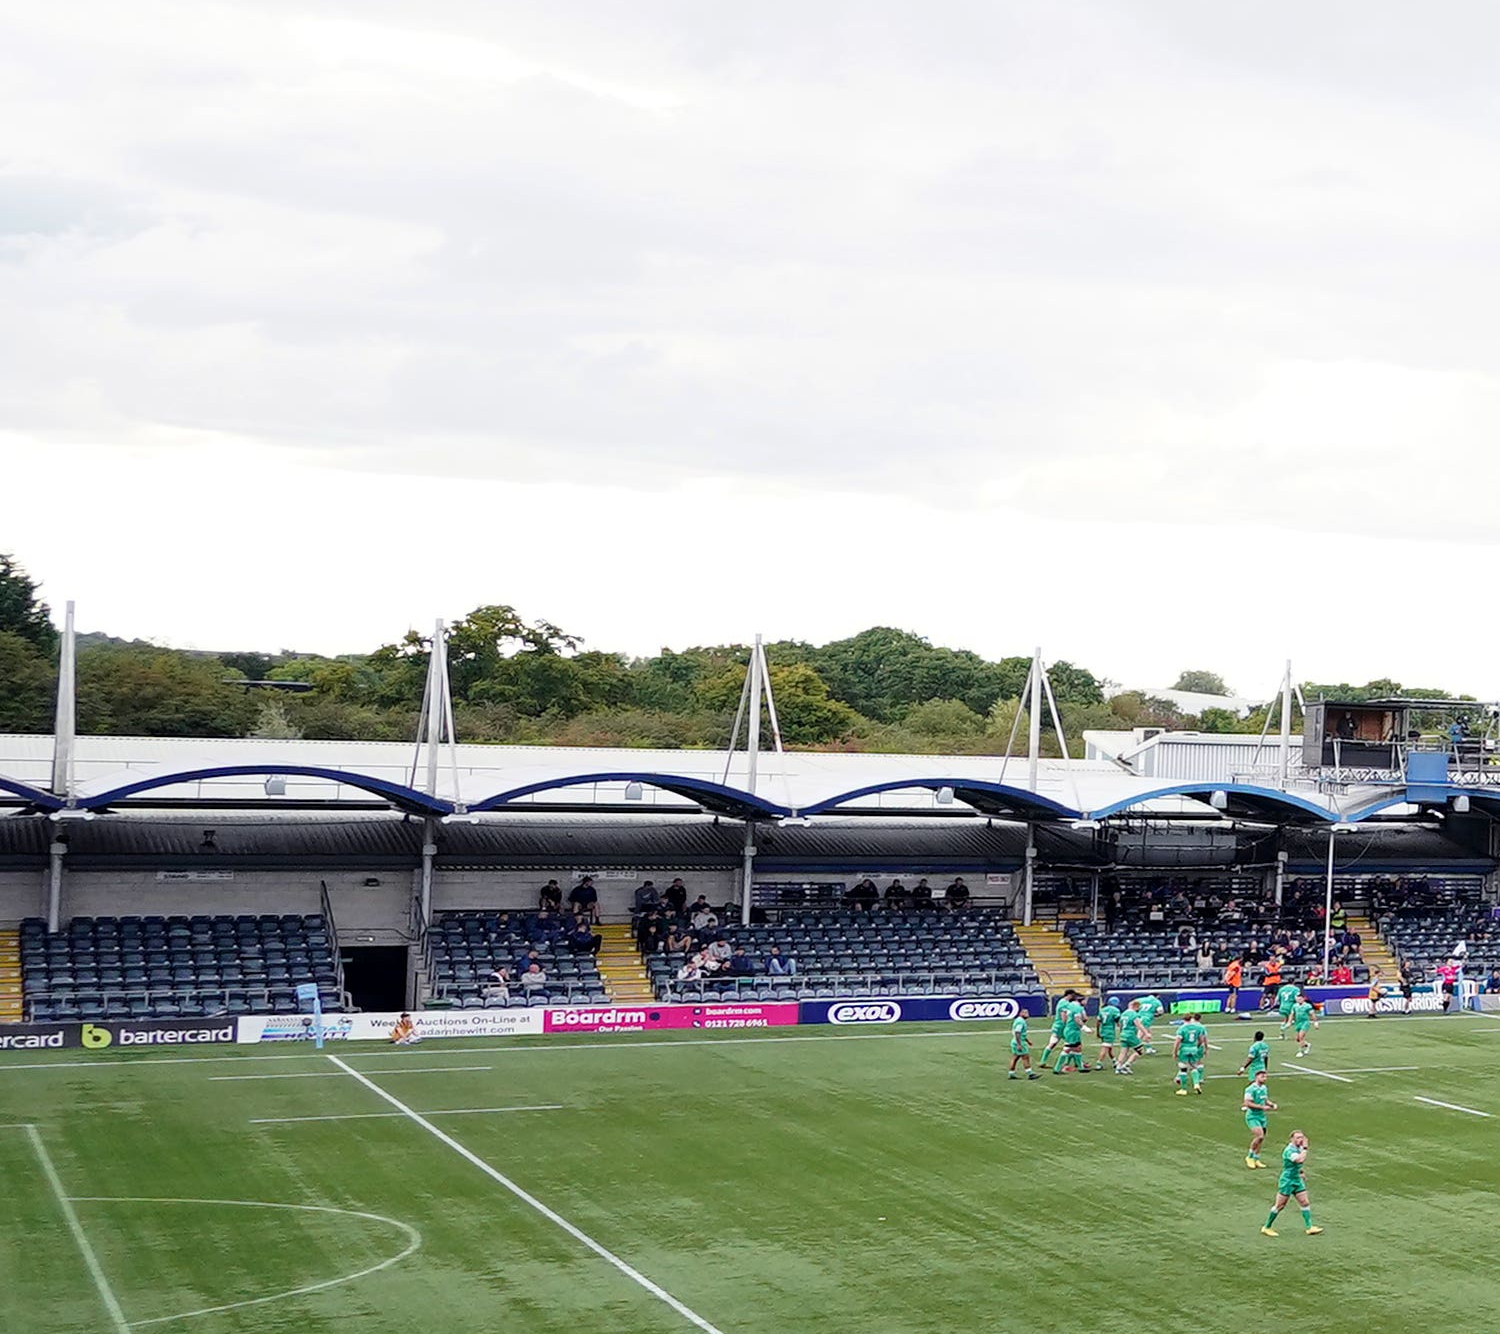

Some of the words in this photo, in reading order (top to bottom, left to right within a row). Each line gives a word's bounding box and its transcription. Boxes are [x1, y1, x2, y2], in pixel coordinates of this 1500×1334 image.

[416, 1017, 468, 1027] Auctions
[472, 1016, 516, 1025] On-Line
[519, 1016, 531, 1024] at
[551, 1010, 646, 1025] Boardrm
[120, 1026, 233, 1044] bartercard
